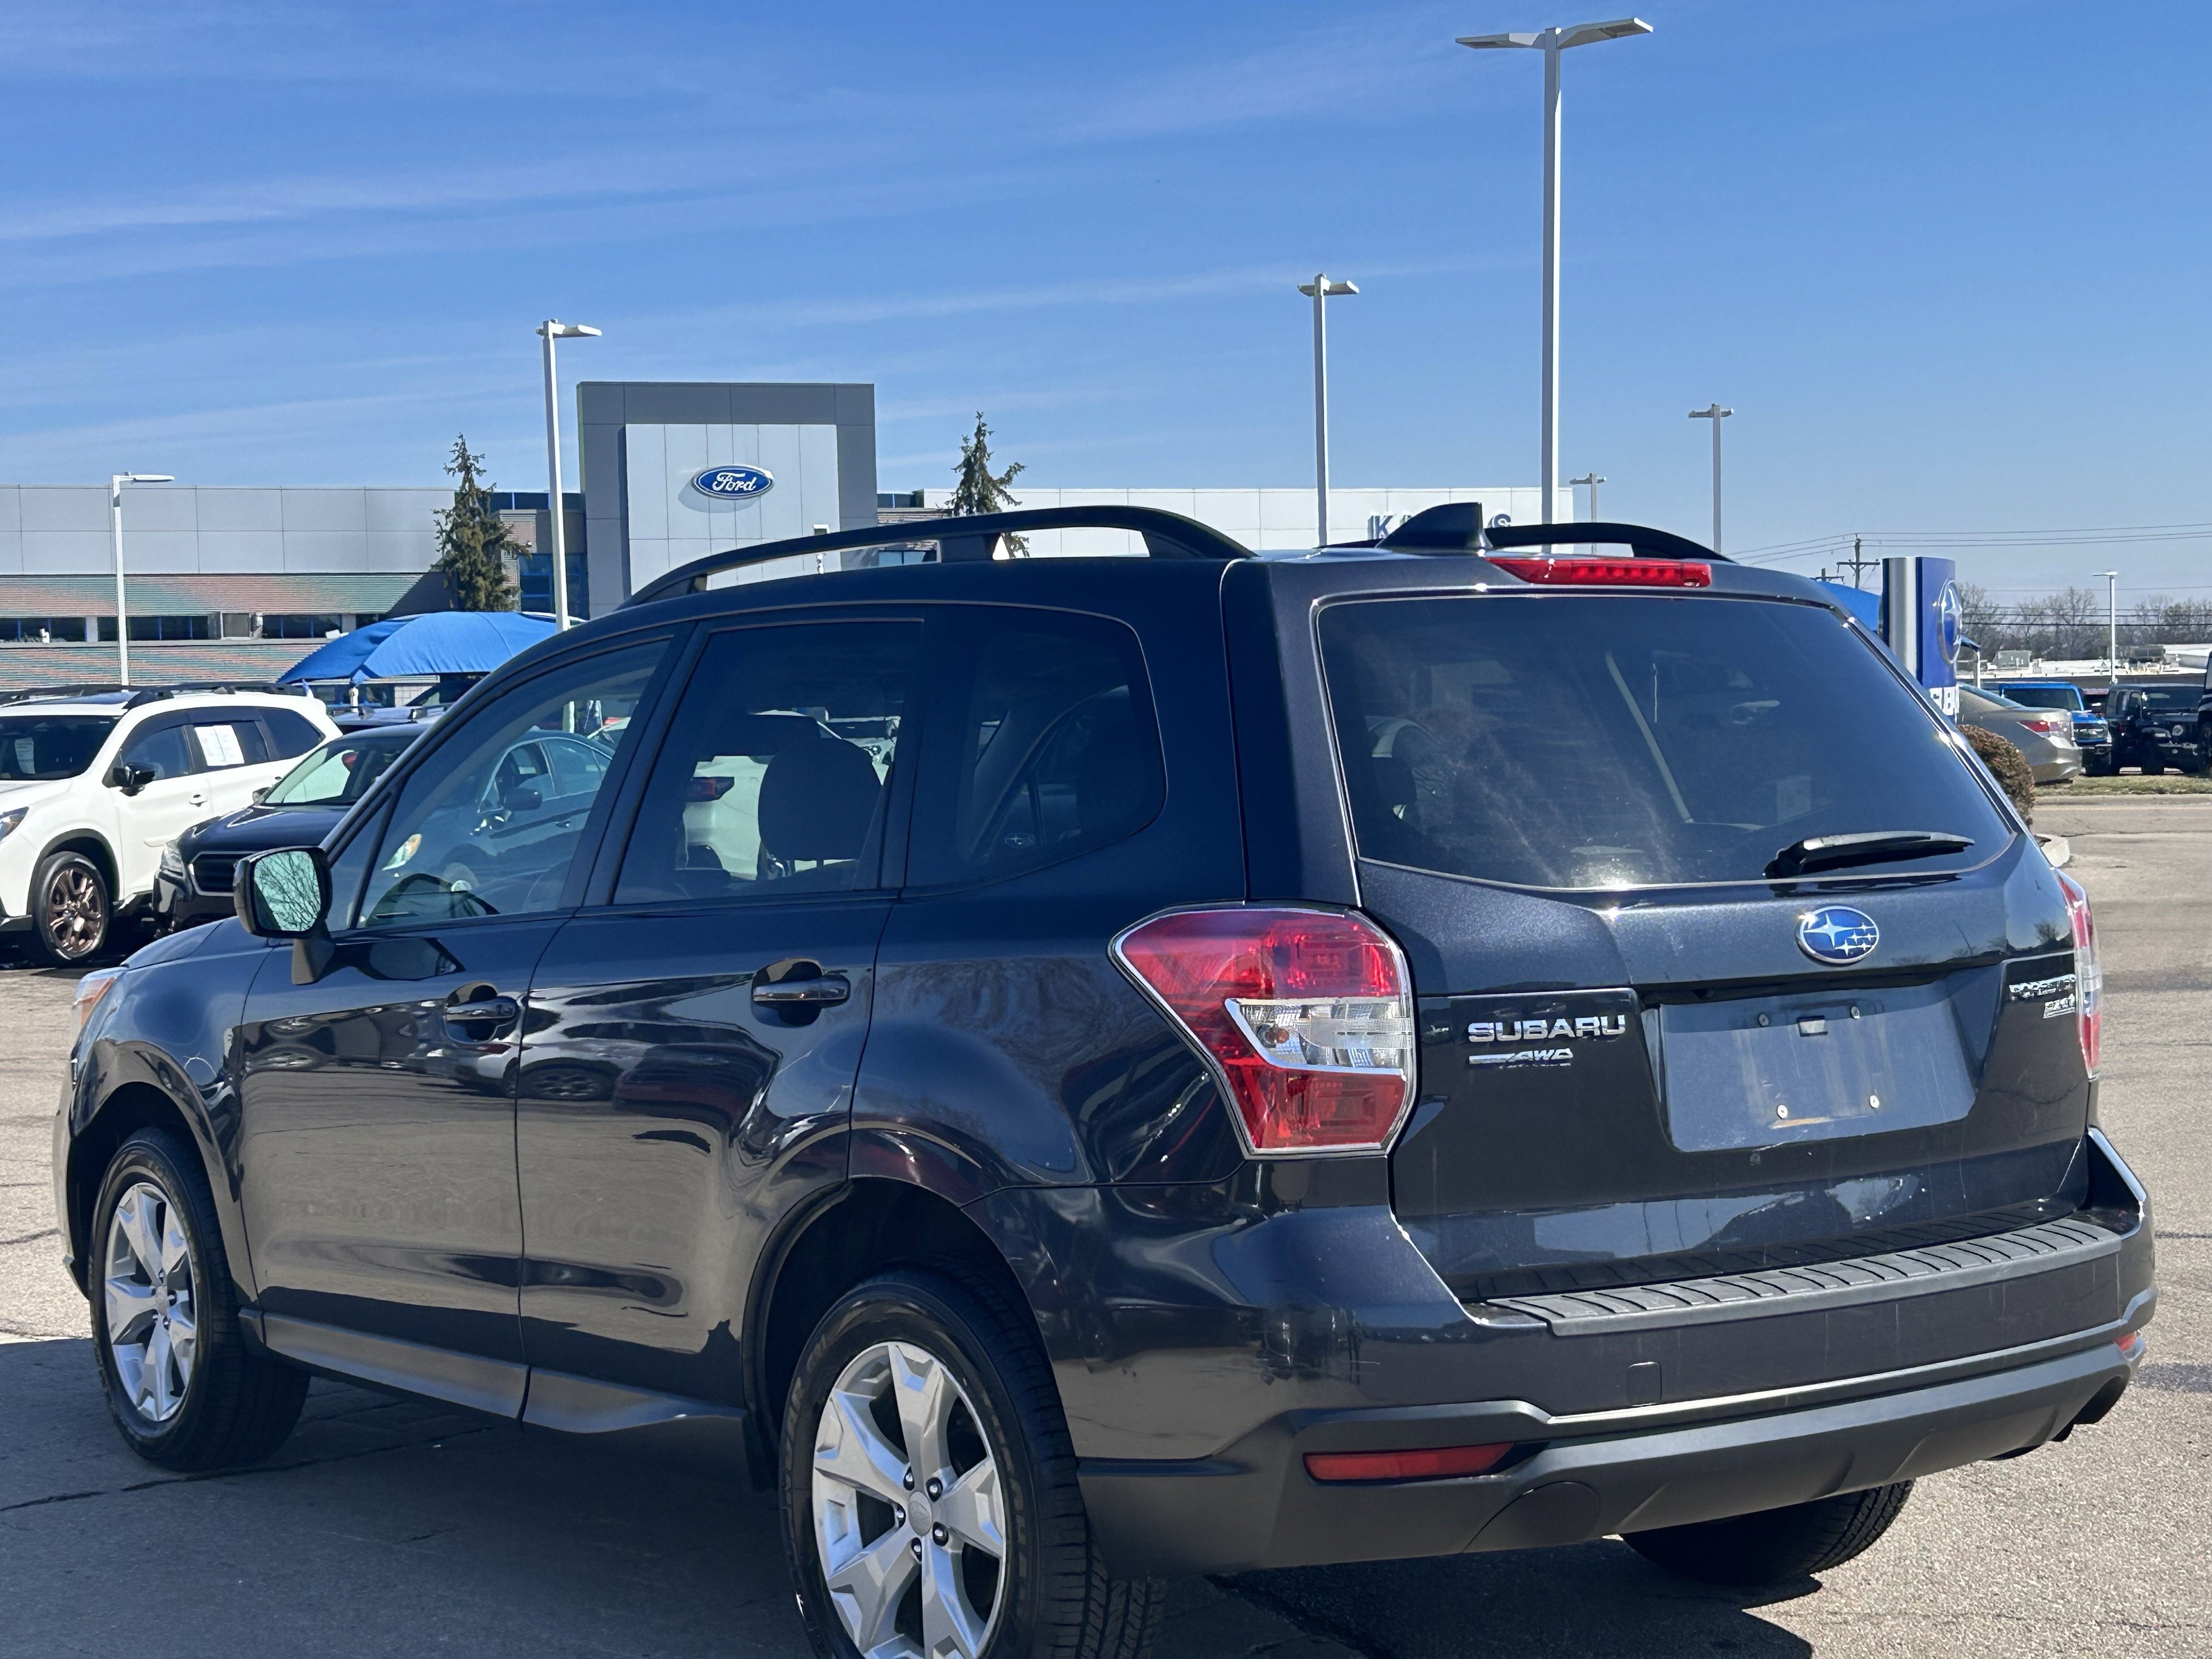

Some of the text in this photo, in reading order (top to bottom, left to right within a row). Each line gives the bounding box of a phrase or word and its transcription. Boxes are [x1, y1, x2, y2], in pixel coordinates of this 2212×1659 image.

[713, 472, 757, 491] Ford
[1468, 1015, 1626, 1042] SUBARU
[1508, 1048, 1573, 1063] AWD
